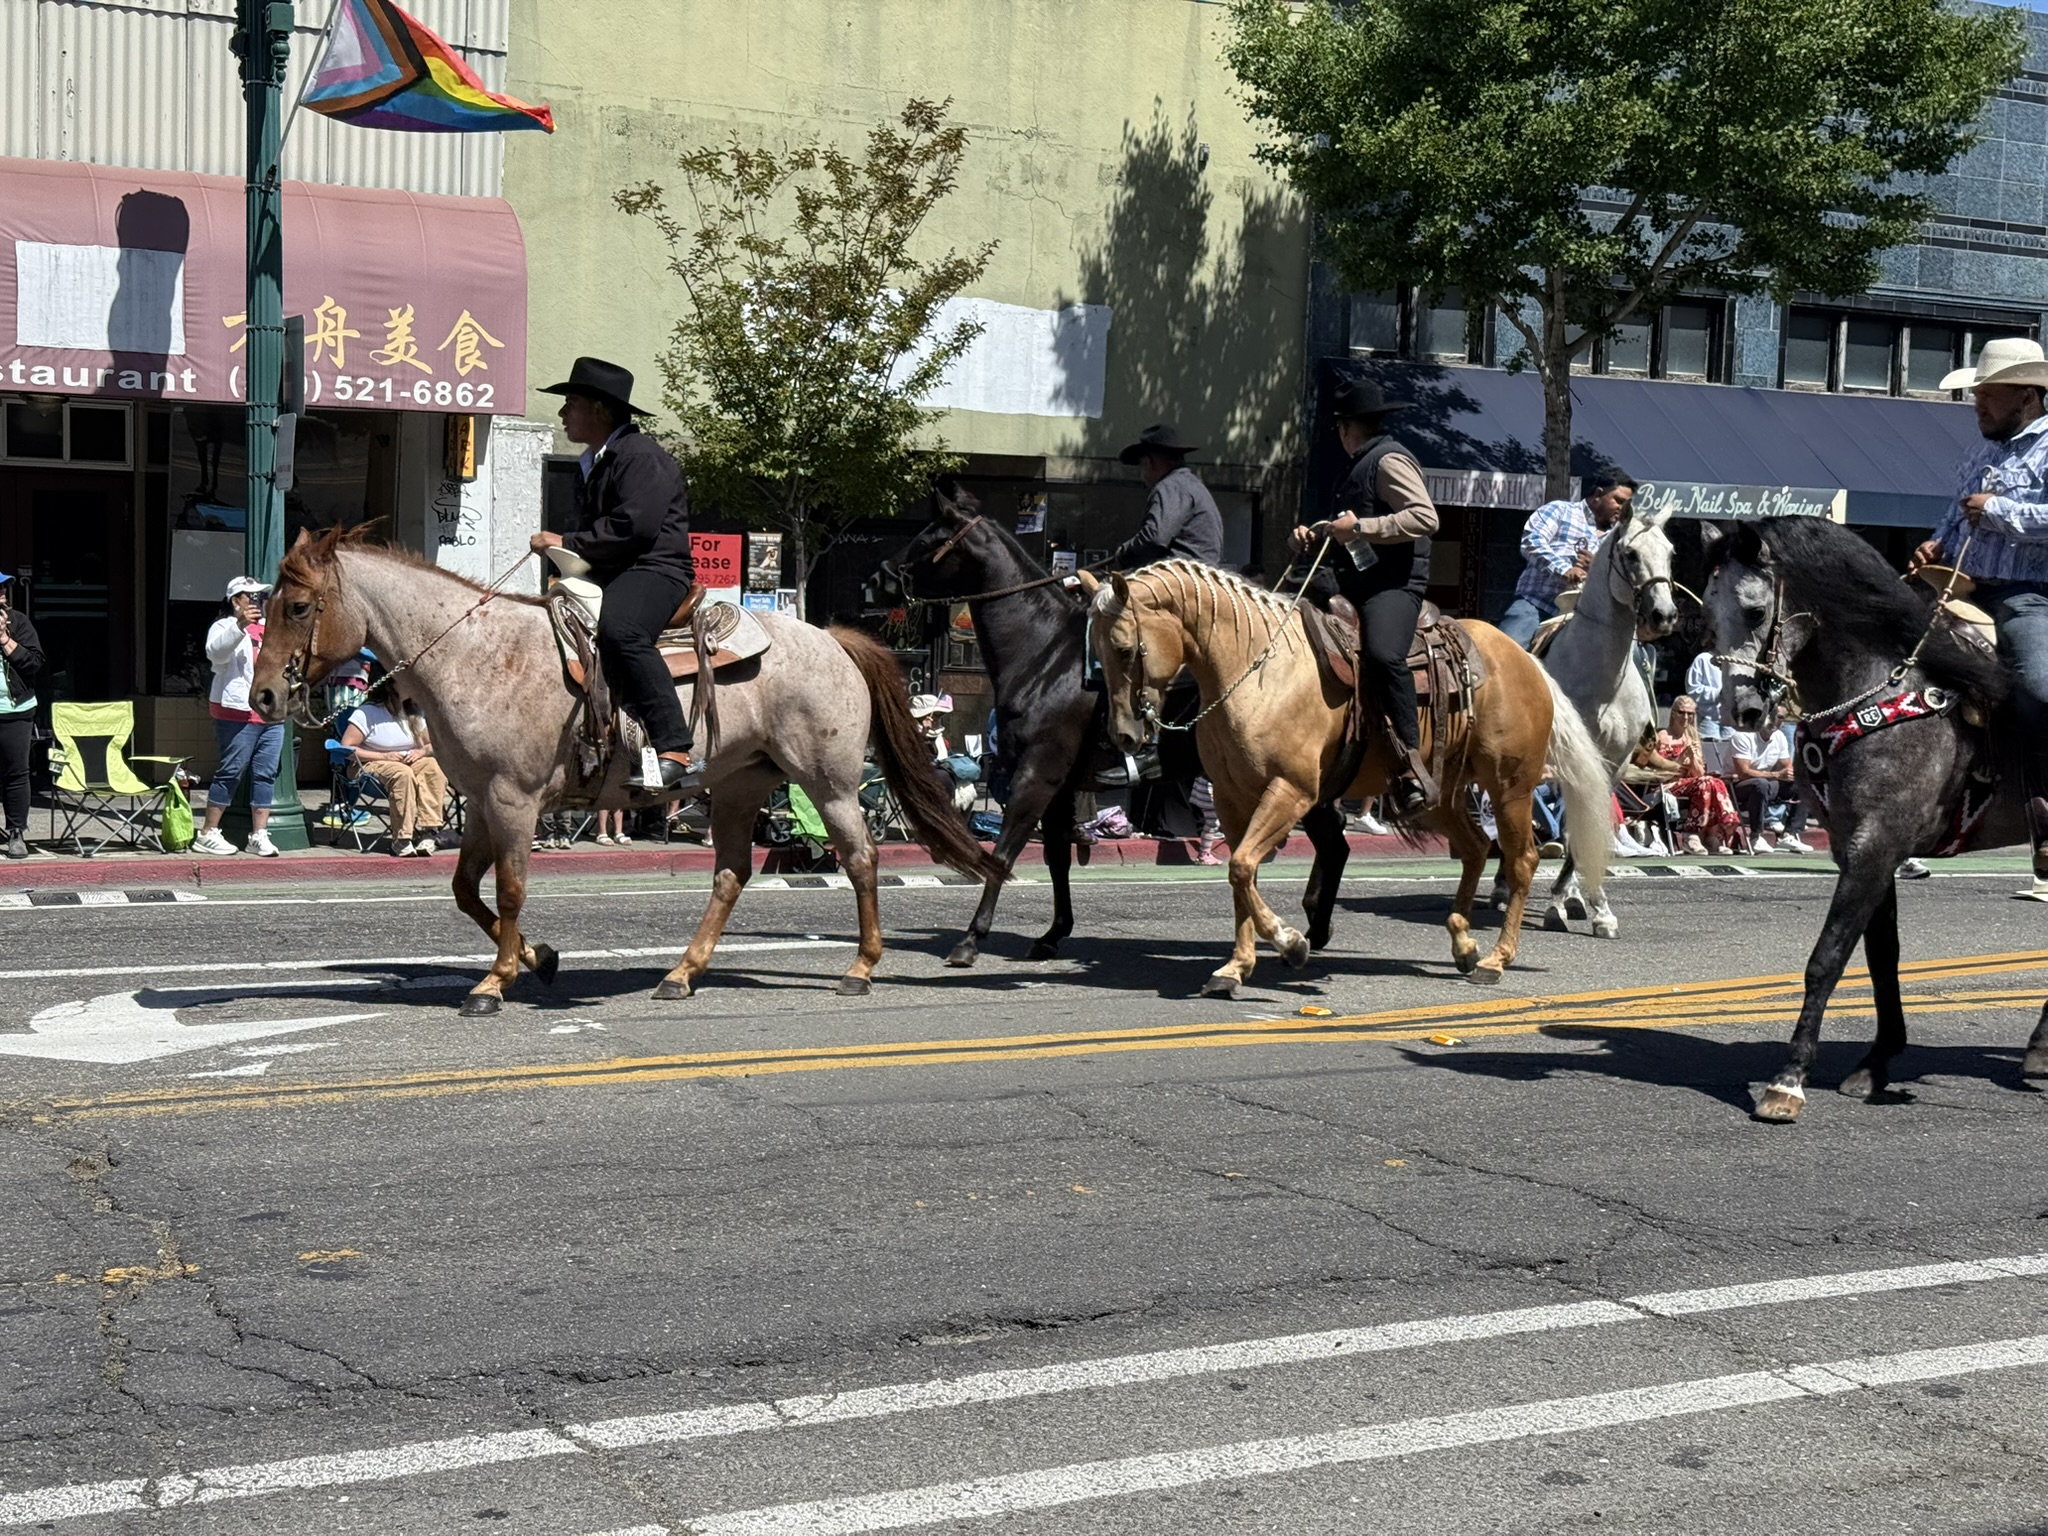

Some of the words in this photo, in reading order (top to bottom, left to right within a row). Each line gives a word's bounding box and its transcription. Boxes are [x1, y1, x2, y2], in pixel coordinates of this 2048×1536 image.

[0, 358, 197, 393] taurant
[334, 375, 495, 408] 521-6862
[1425, 474, 1467, 502] ITTLE
[1684, 486, 1722, 514] Nail
[1725, 491, 1753, 519] Spa
[1757, 490, 1771, 515] &
[690, 536, 721, 551] For
[1466, 509, 1478, 568] RTUNE
[692, 556, 731, 570] ease
[694, 573, 711, 584] 95
[713, 574, 737, 585] 7262
